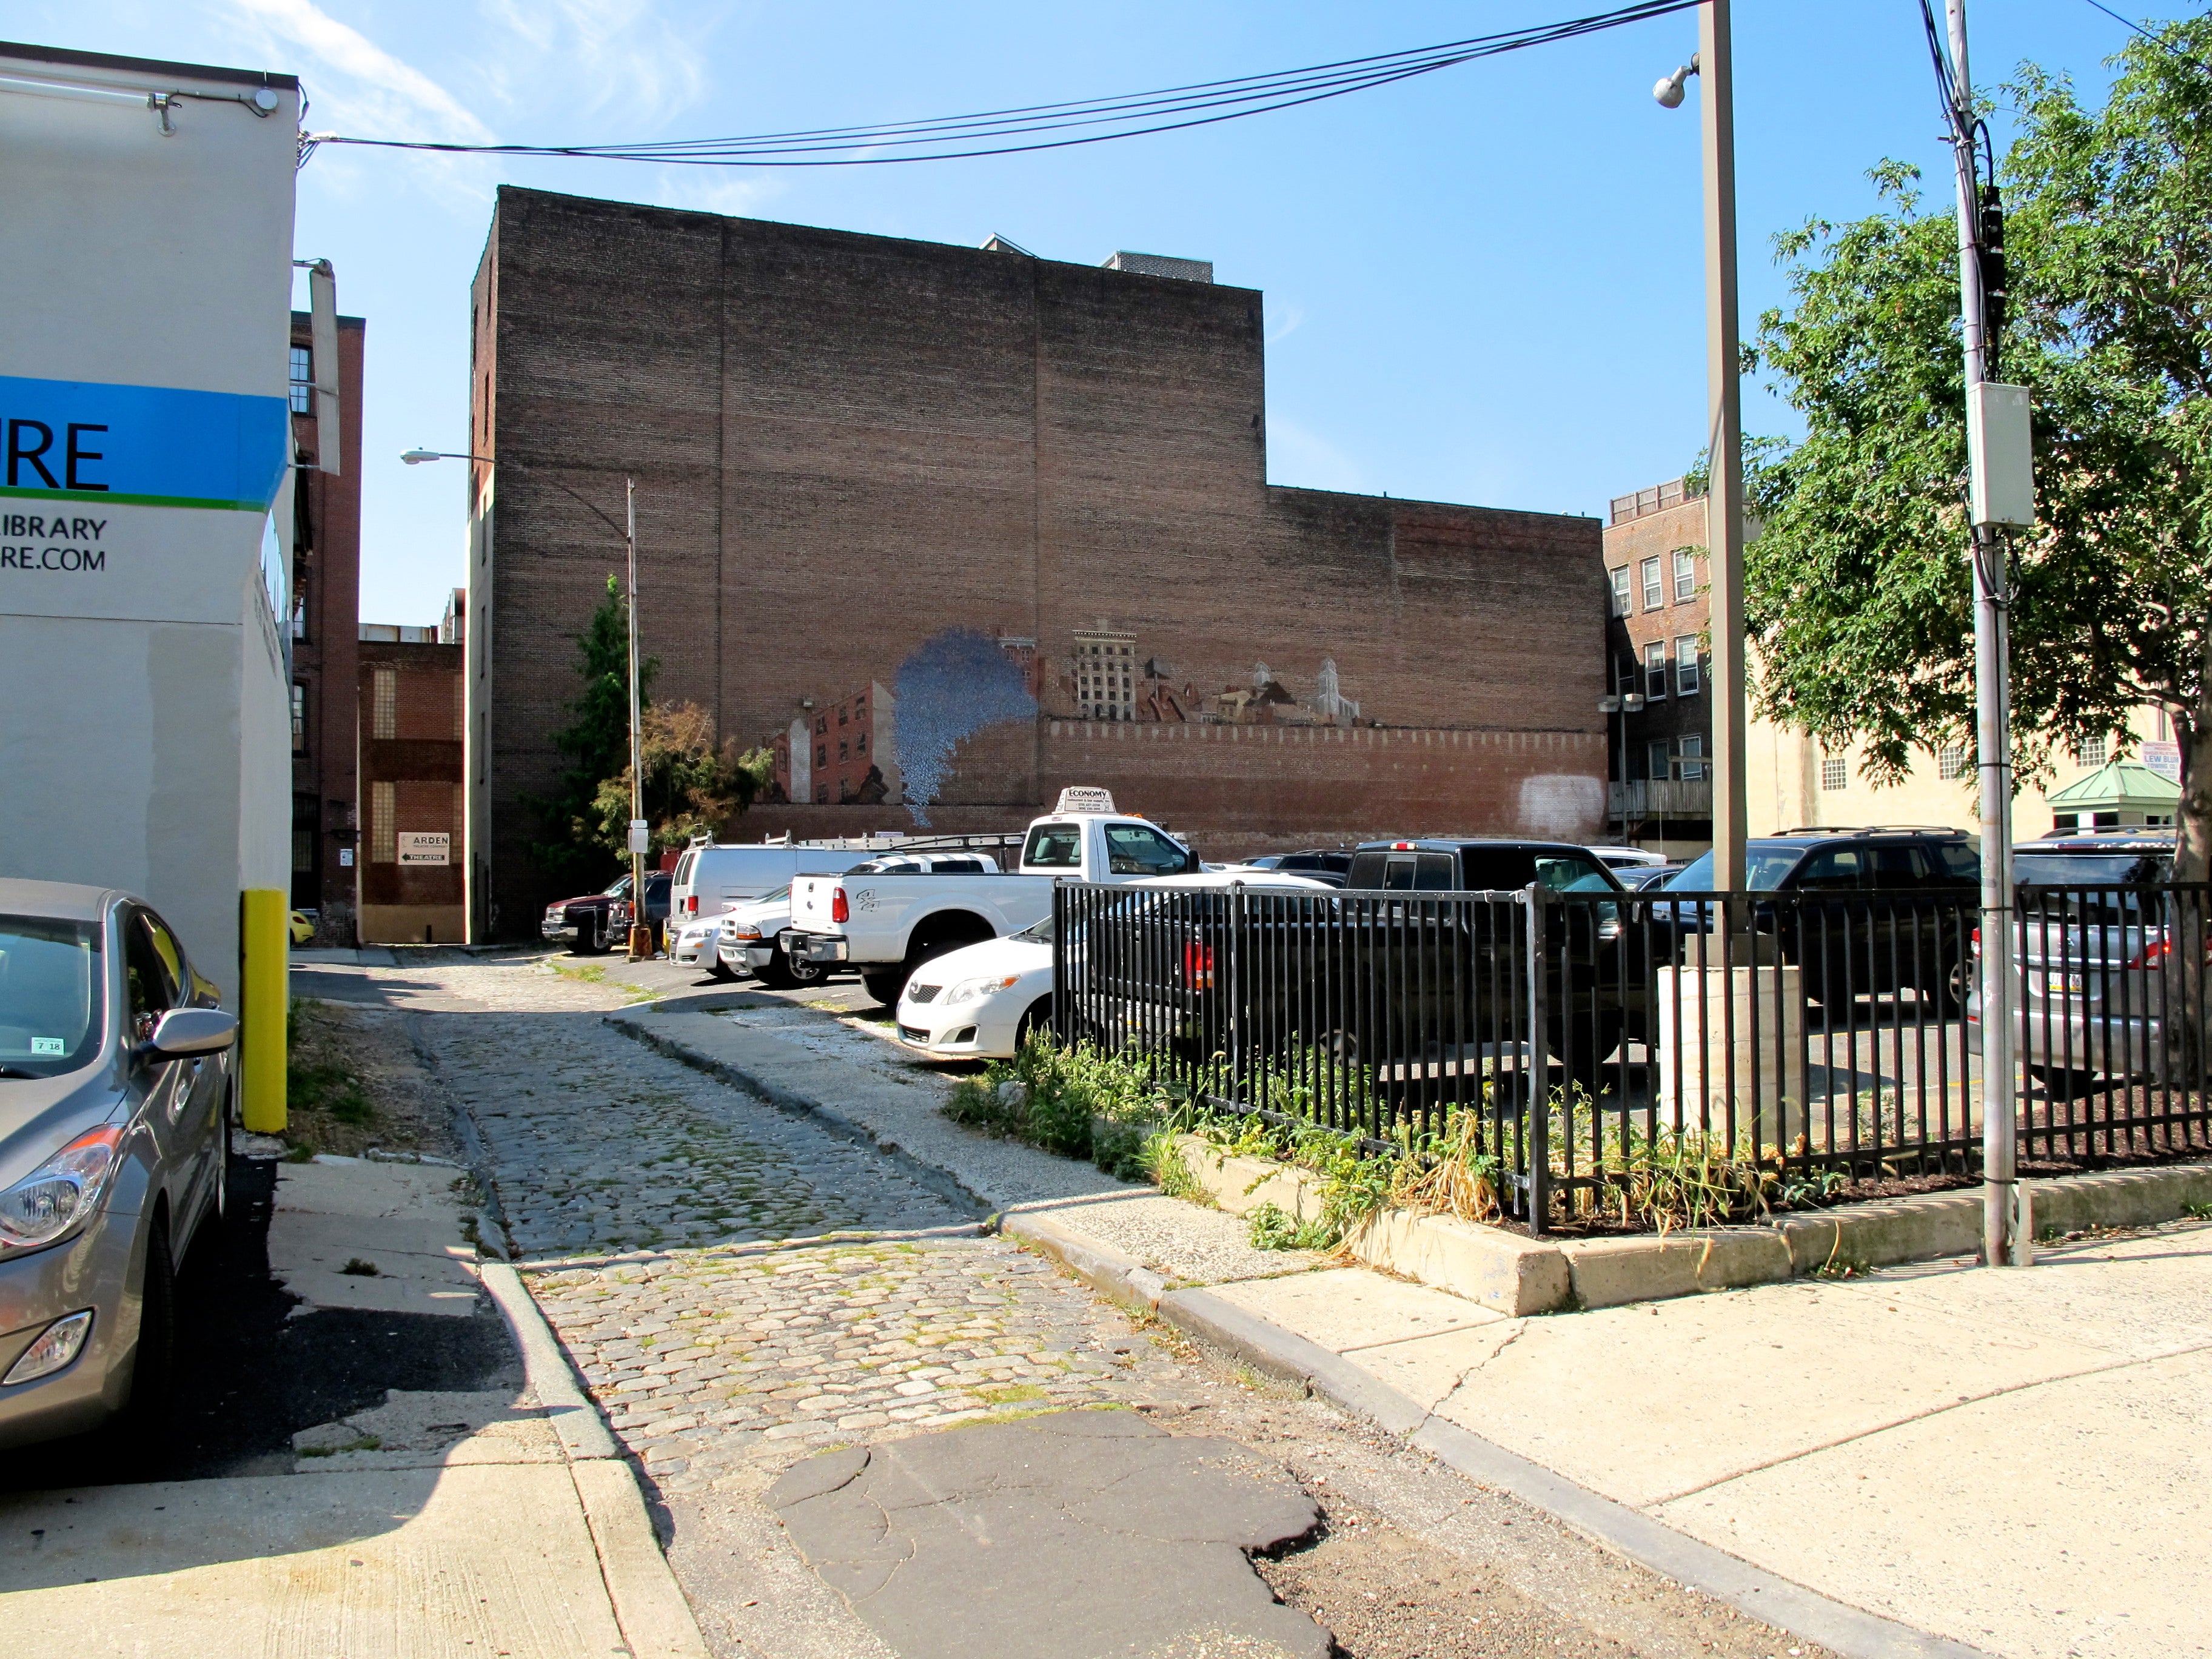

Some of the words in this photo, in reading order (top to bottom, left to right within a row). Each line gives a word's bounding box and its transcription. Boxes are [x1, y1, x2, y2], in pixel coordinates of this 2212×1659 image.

[0, 418, 109, 492] RE
[0, 514, 107, 540] IBRARY
[1069, 790, 1107, 800] ECONOMY
